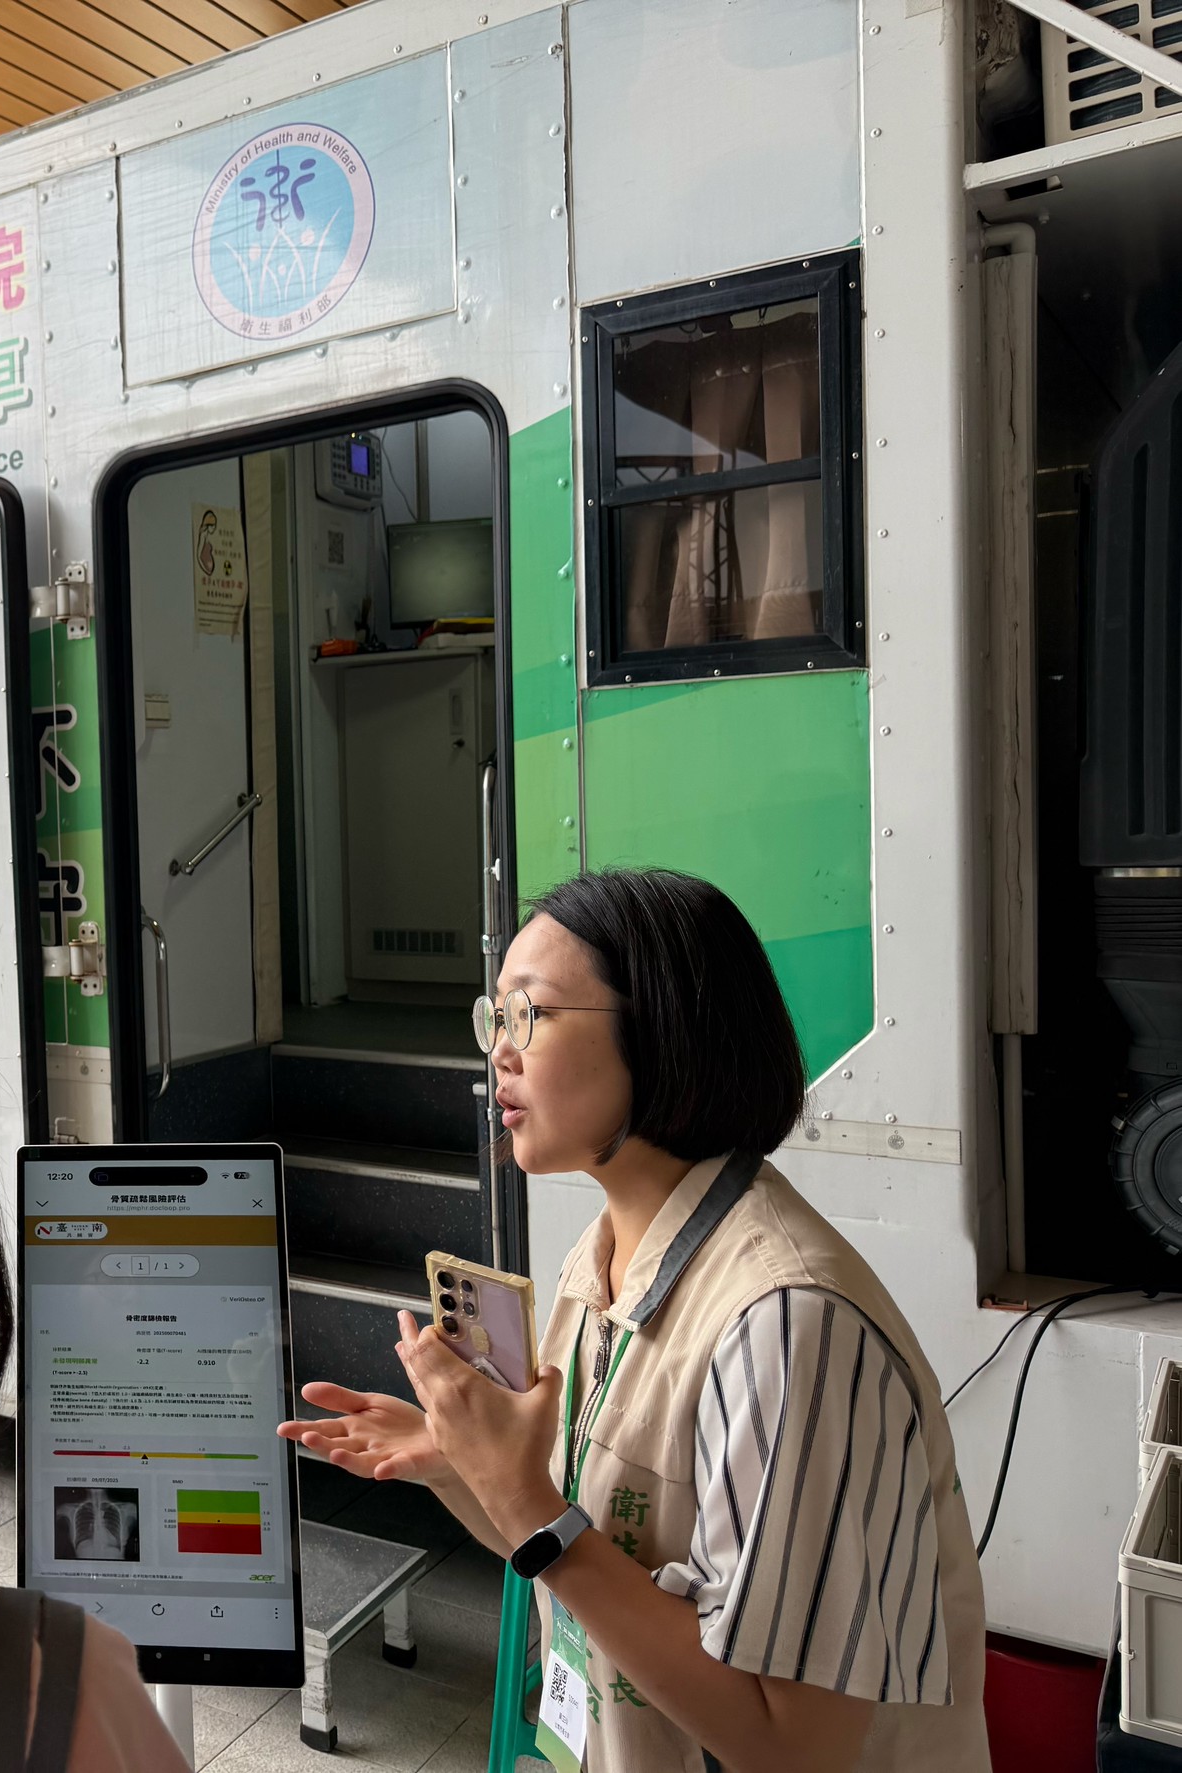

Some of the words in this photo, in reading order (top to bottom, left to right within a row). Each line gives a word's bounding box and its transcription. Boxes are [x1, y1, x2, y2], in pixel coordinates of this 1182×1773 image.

[206, 166, 239, 214] Ministry
[240, 149, 252, 163] of
[254, 131, 293, 155] Health
[296, 132, 320, 143] and
[322, 134, 357, 174] Welfare
[239, 294, 332, 335] 衛生福利部
[47, 1173, 73, 1181] 12:20
